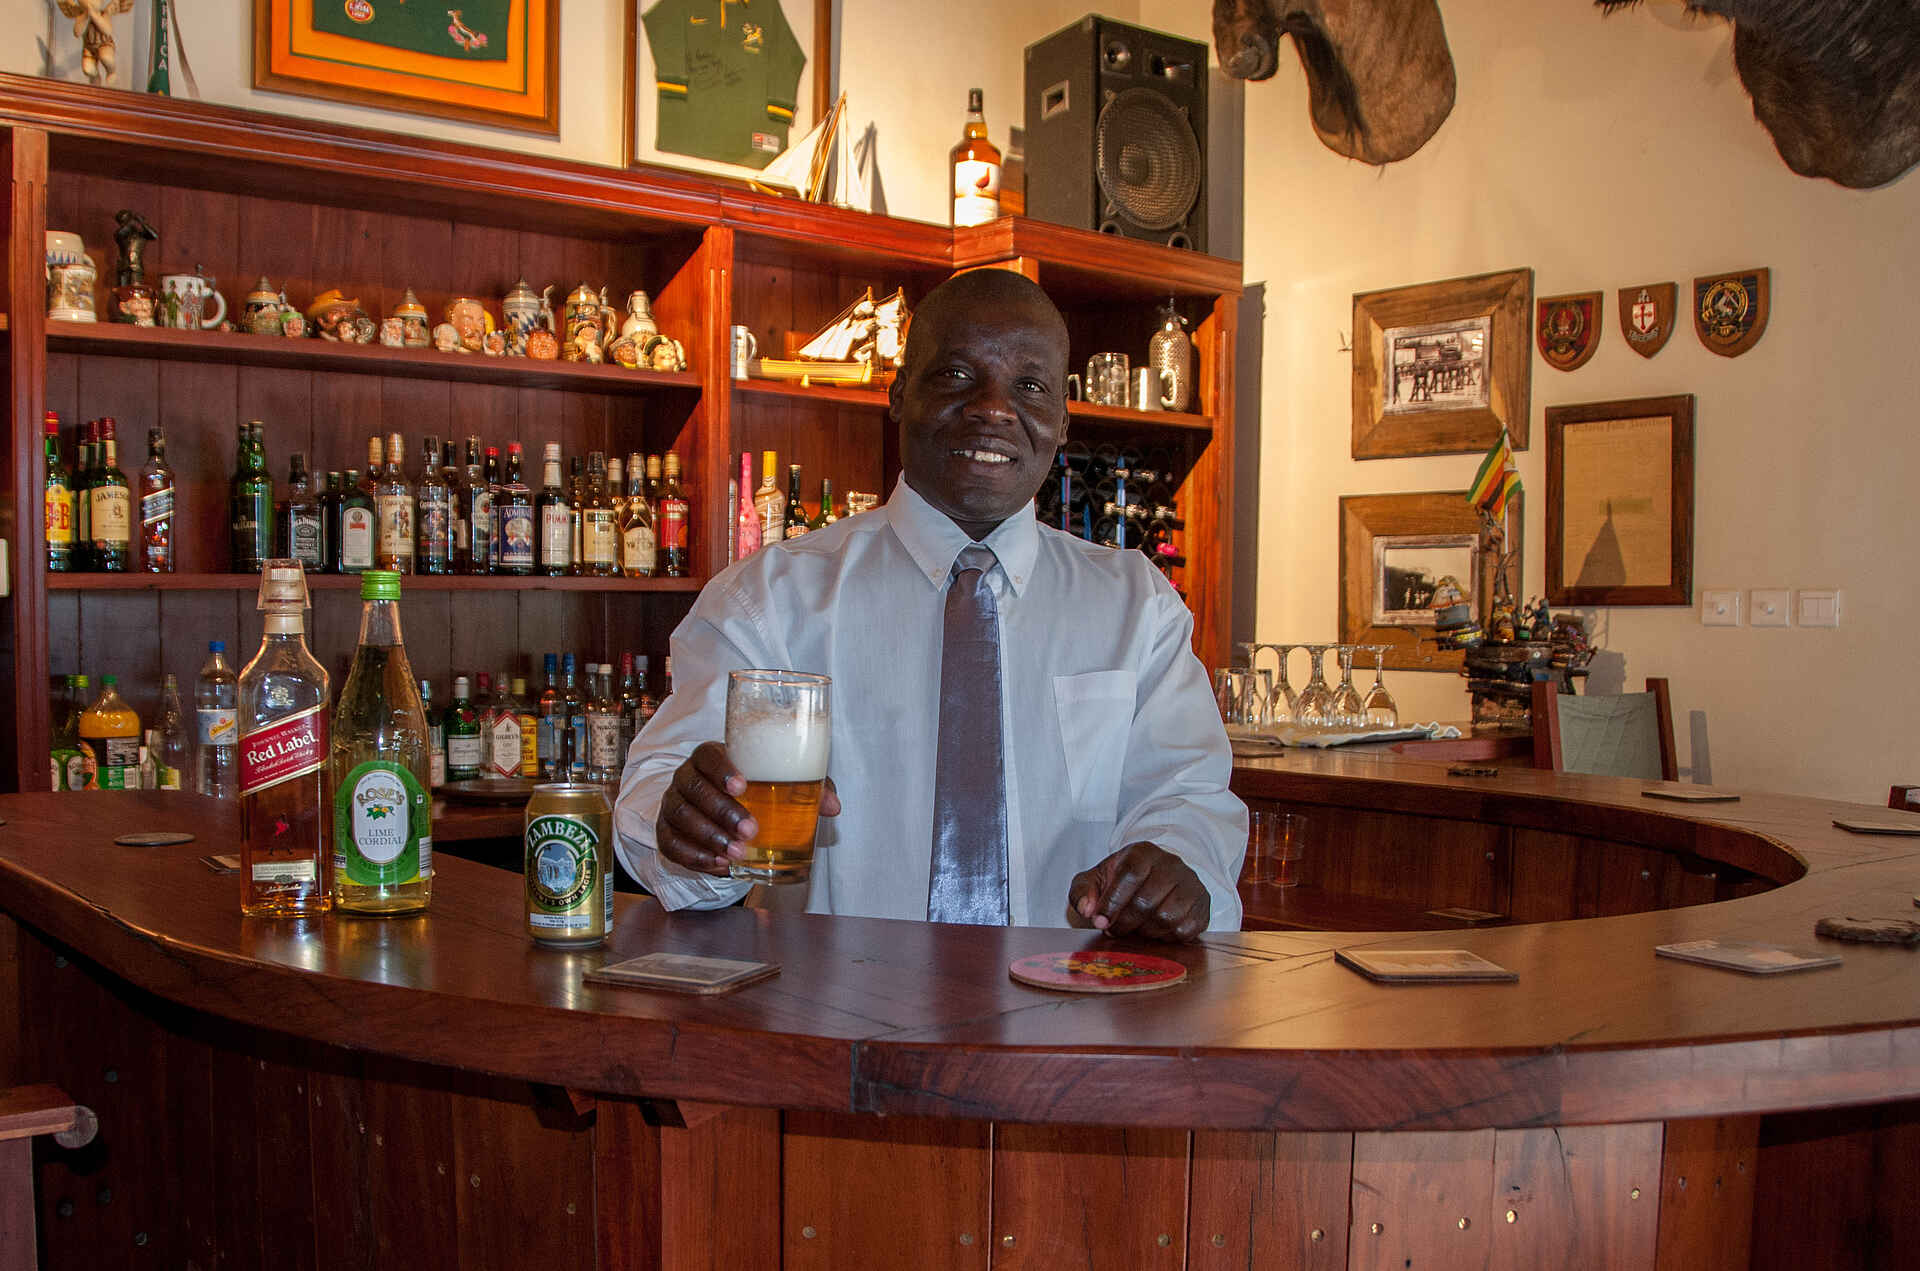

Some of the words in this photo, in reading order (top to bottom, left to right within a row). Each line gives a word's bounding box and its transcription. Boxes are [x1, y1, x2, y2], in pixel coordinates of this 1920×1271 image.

[158, 0, 168, 70] FRICA
[247, 744, 277, 766] Red
[276, 729, 317, 755] Label
[356, 786, 405, 808] ROSE'S
[358, 836, 405, 846] CORDIAL
[368, 828, 394, 837] LIME
[558, 894, 578, 906] OWN
